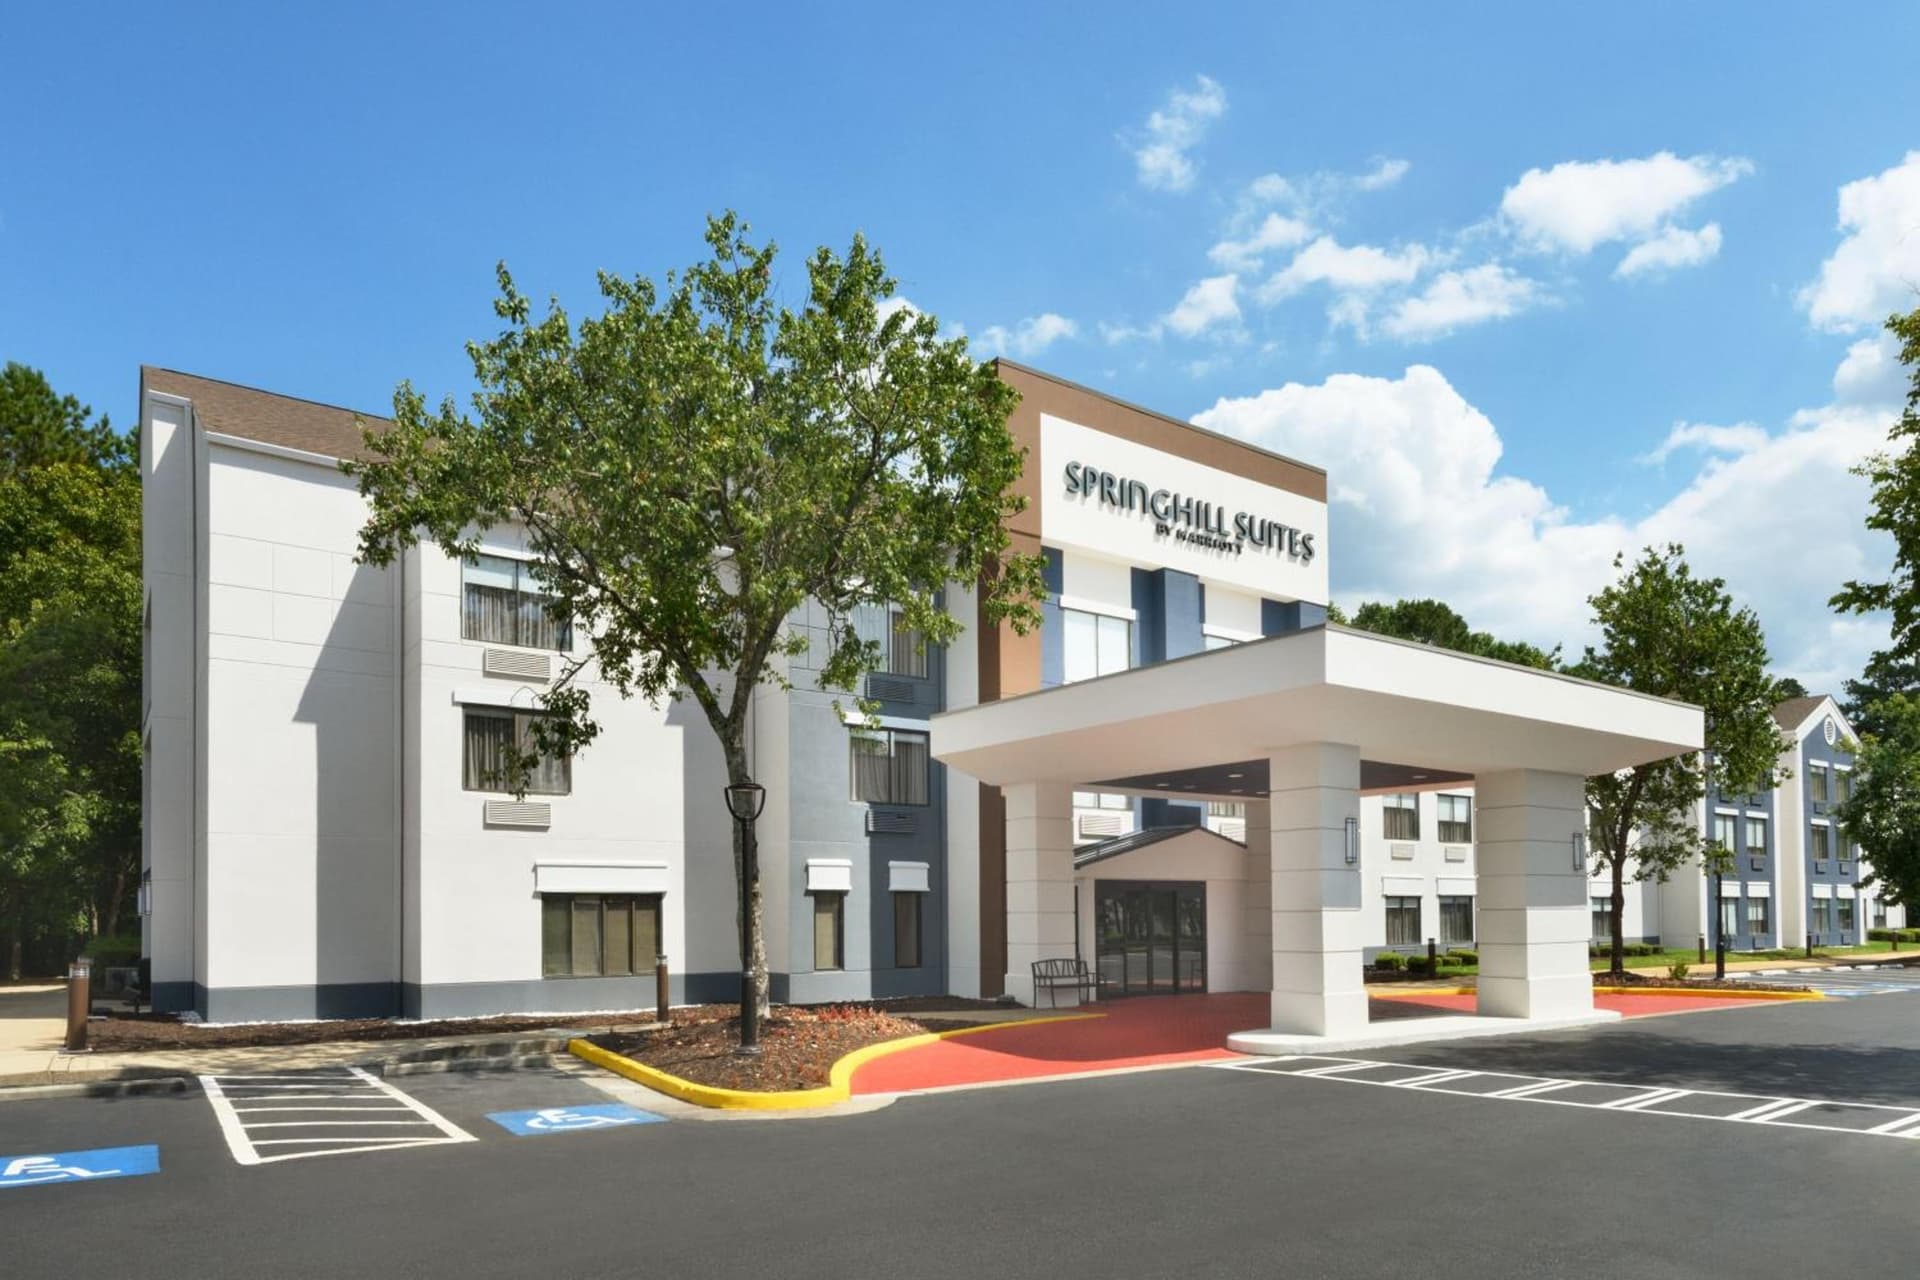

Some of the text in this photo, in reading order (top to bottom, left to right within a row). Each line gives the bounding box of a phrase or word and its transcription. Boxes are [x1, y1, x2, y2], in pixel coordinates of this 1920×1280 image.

[1065, 461, 1315, 561] SPRINGHILL SUITES
[1155, 522, 1243, 555] BY MARRIOTT
